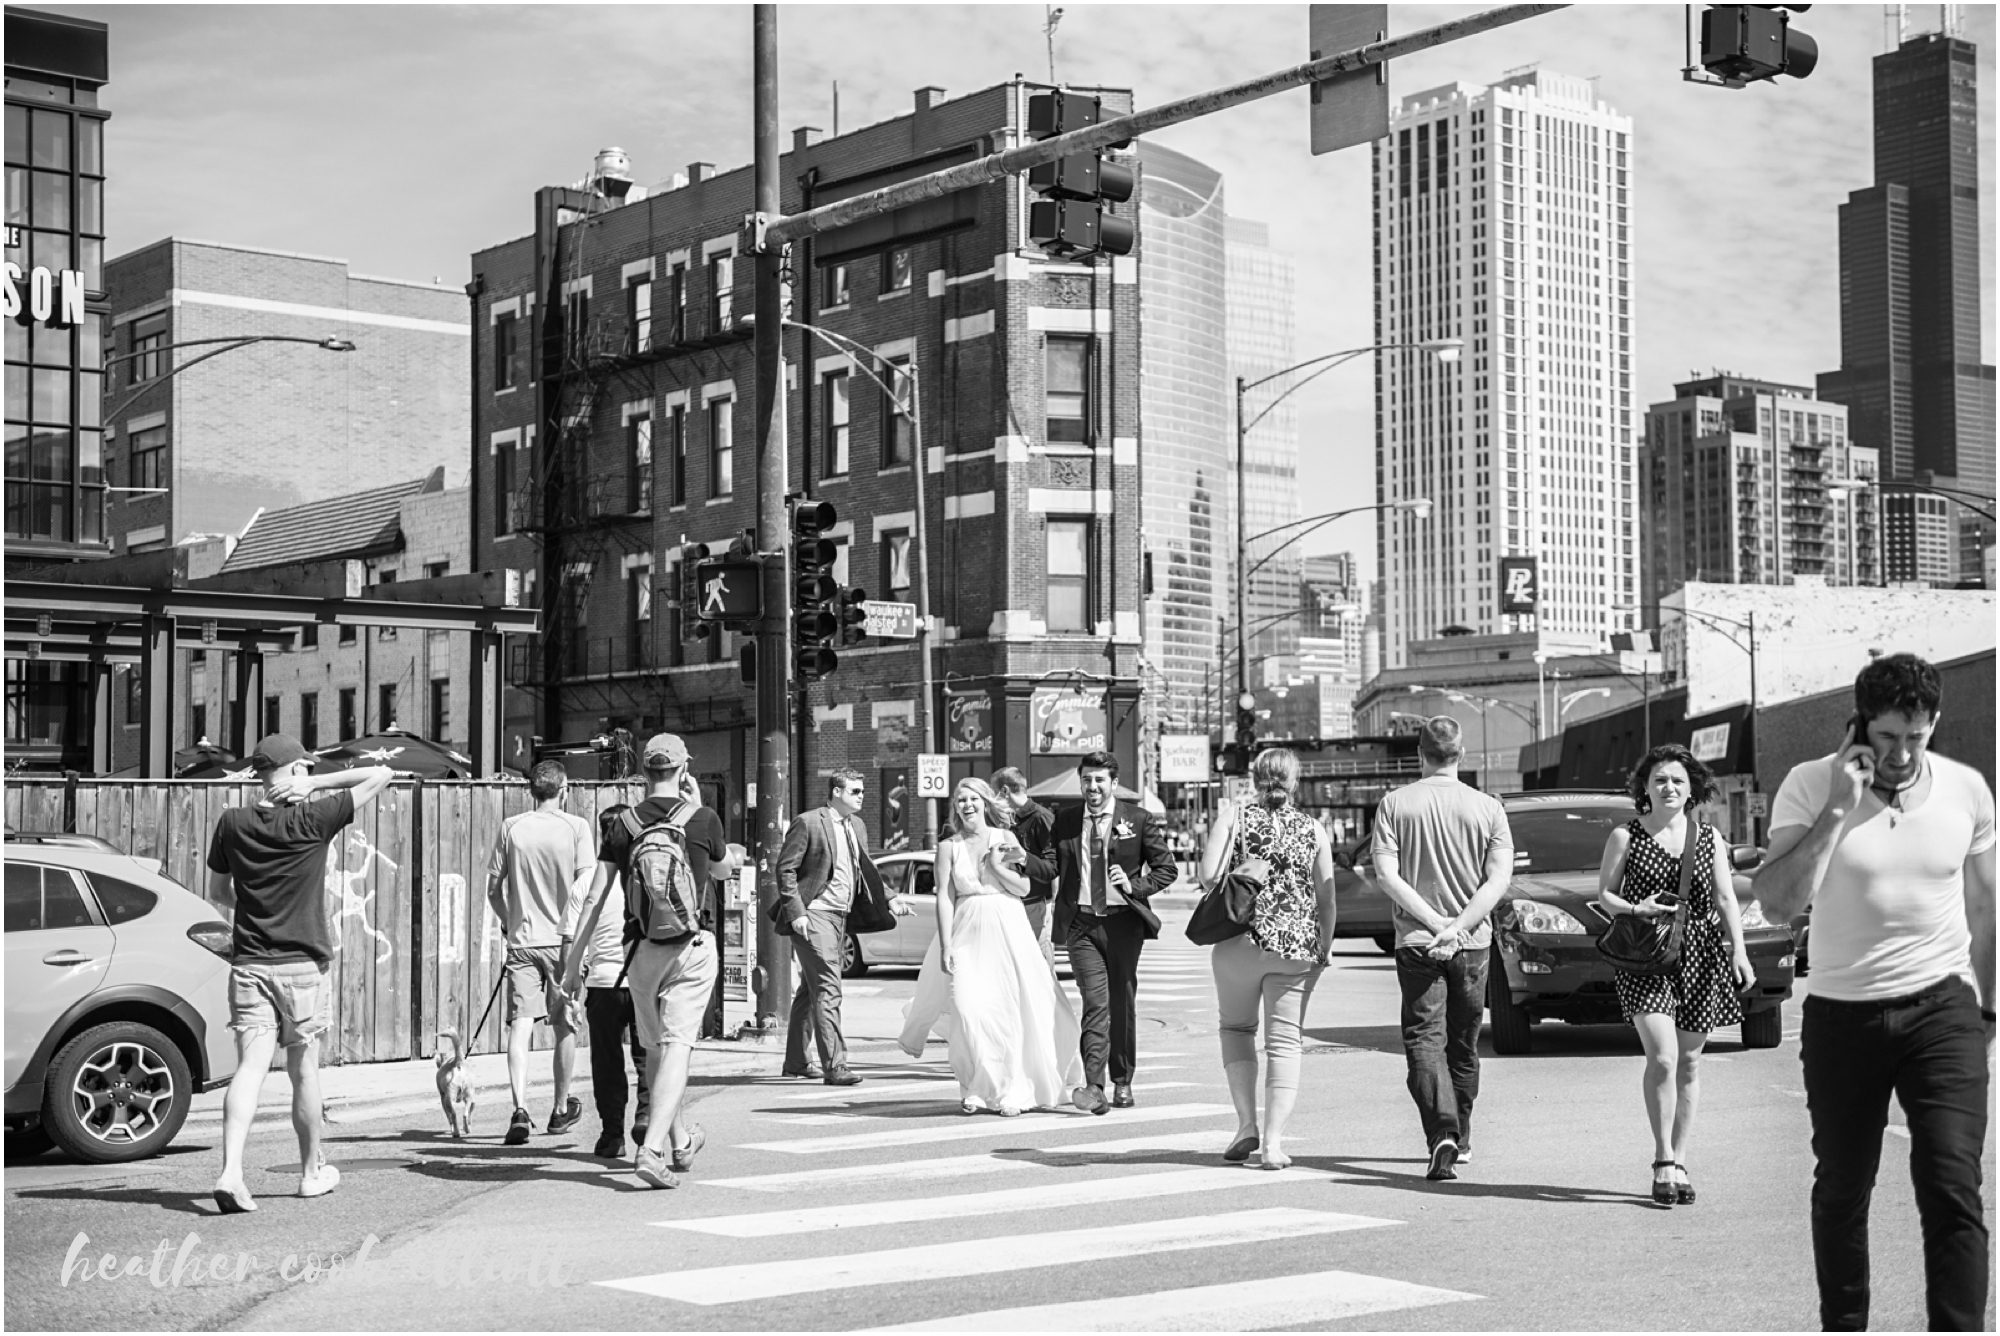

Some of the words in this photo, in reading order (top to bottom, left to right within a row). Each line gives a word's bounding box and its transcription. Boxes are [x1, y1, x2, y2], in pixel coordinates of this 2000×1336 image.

[4, 226, 19, 245] HE
[4, 261, 84, 324] SON
[1036, 731, 1070, 748] IRISH
[1077, 733, 1104, 748] PUB
[922, 758, 945, 766] SPEED
[1173, 757, 1197, 767] BAR
[923, 776, 944, 789] 30
